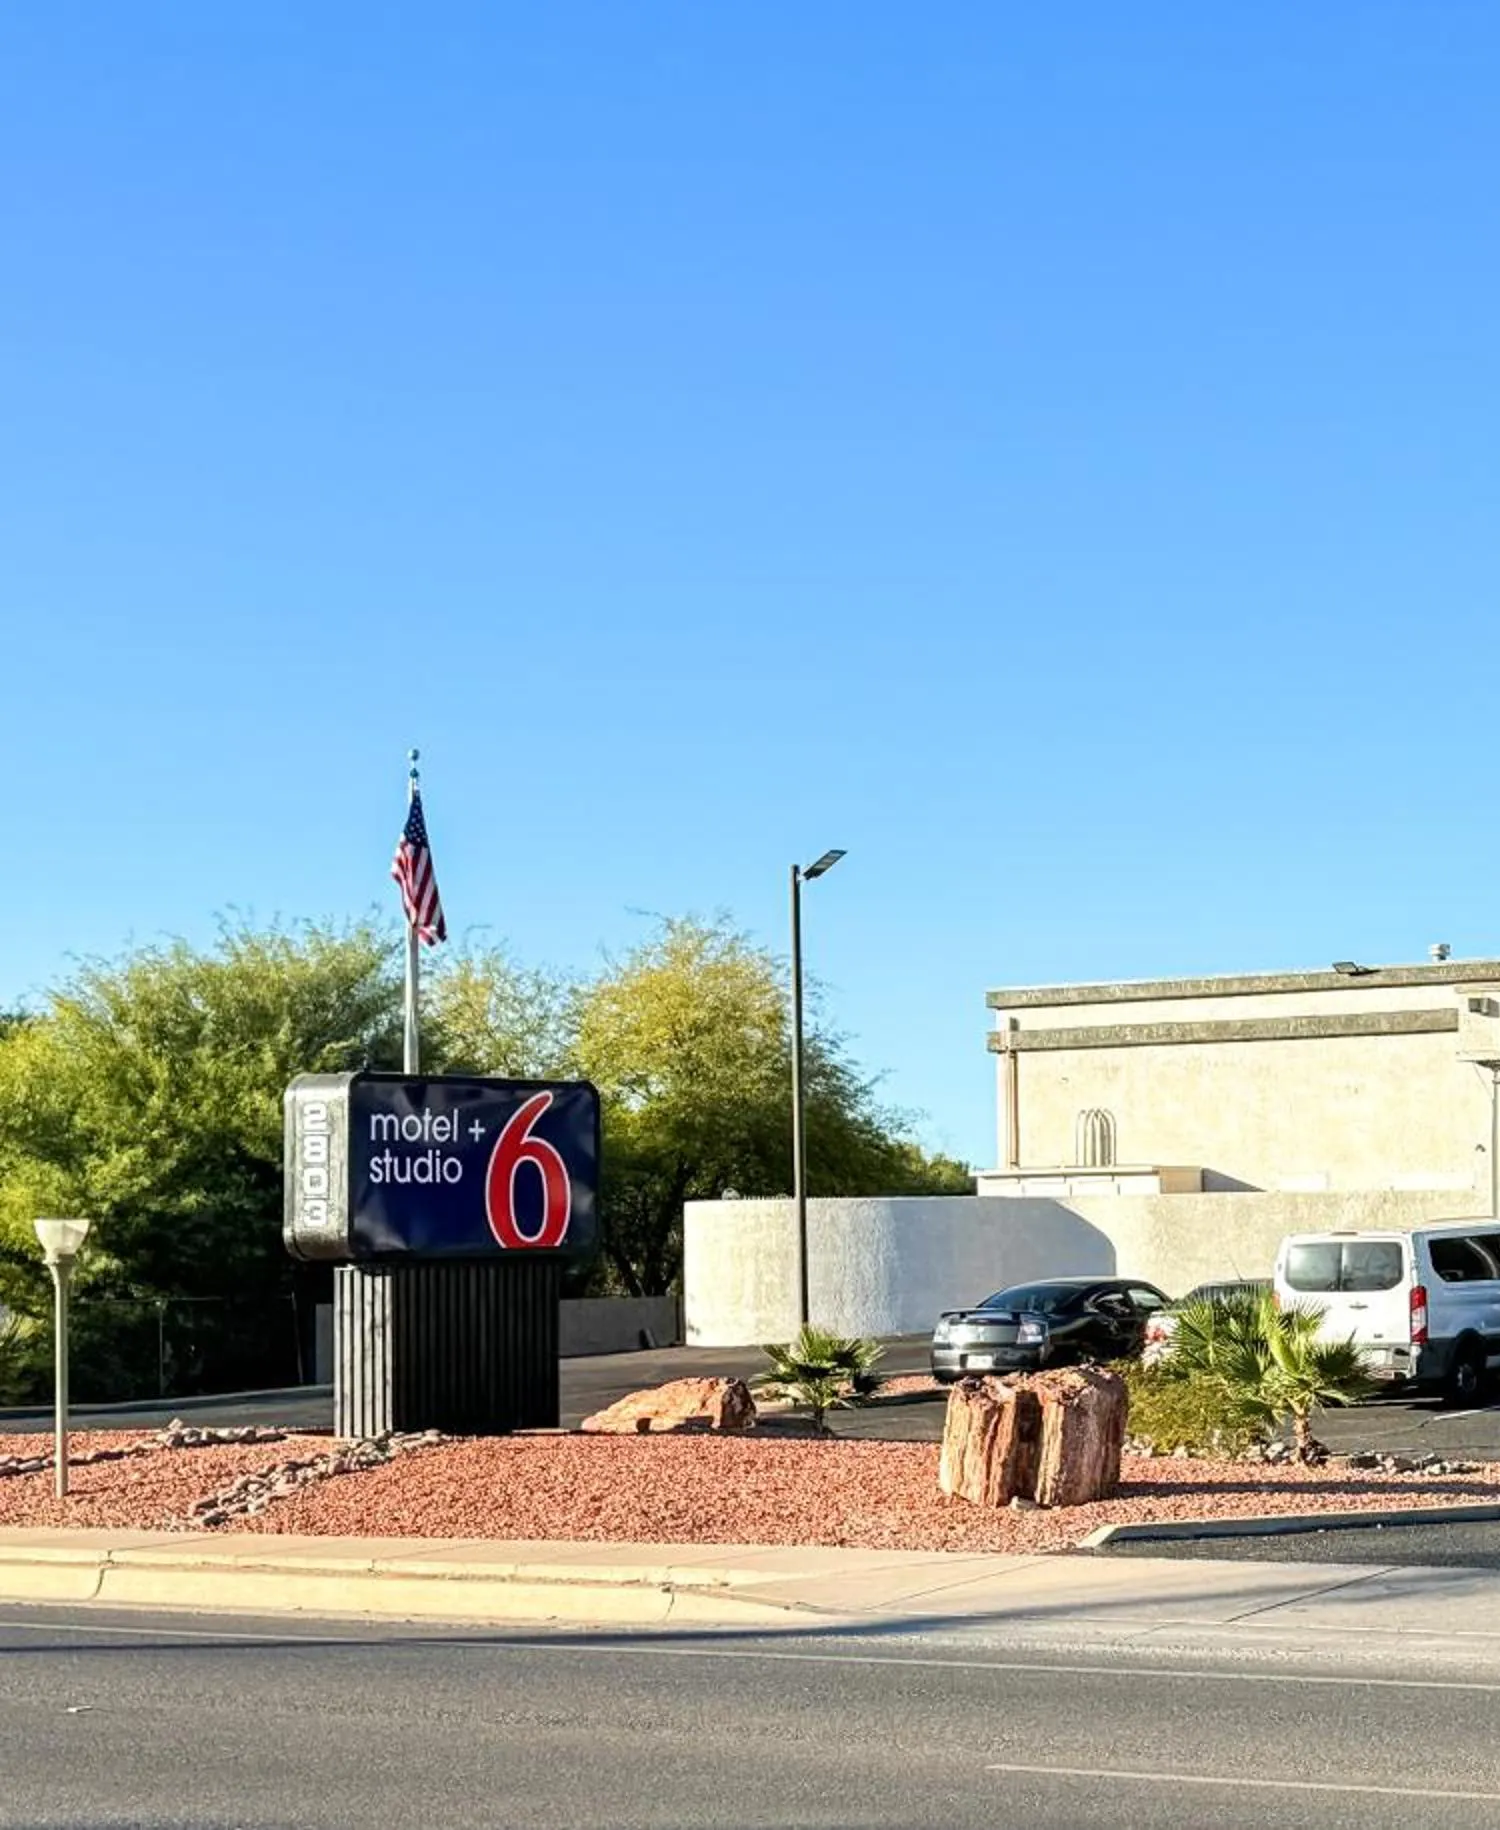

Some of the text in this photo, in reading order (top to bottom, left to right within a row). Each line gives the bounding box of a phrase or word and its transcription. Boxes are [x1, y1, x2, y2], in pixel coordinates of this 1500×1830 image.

[371, 1107, 458, 1142] motel
[370, 1148, 463, 1183] studio
[485, 1090, 571, 1248] 6
